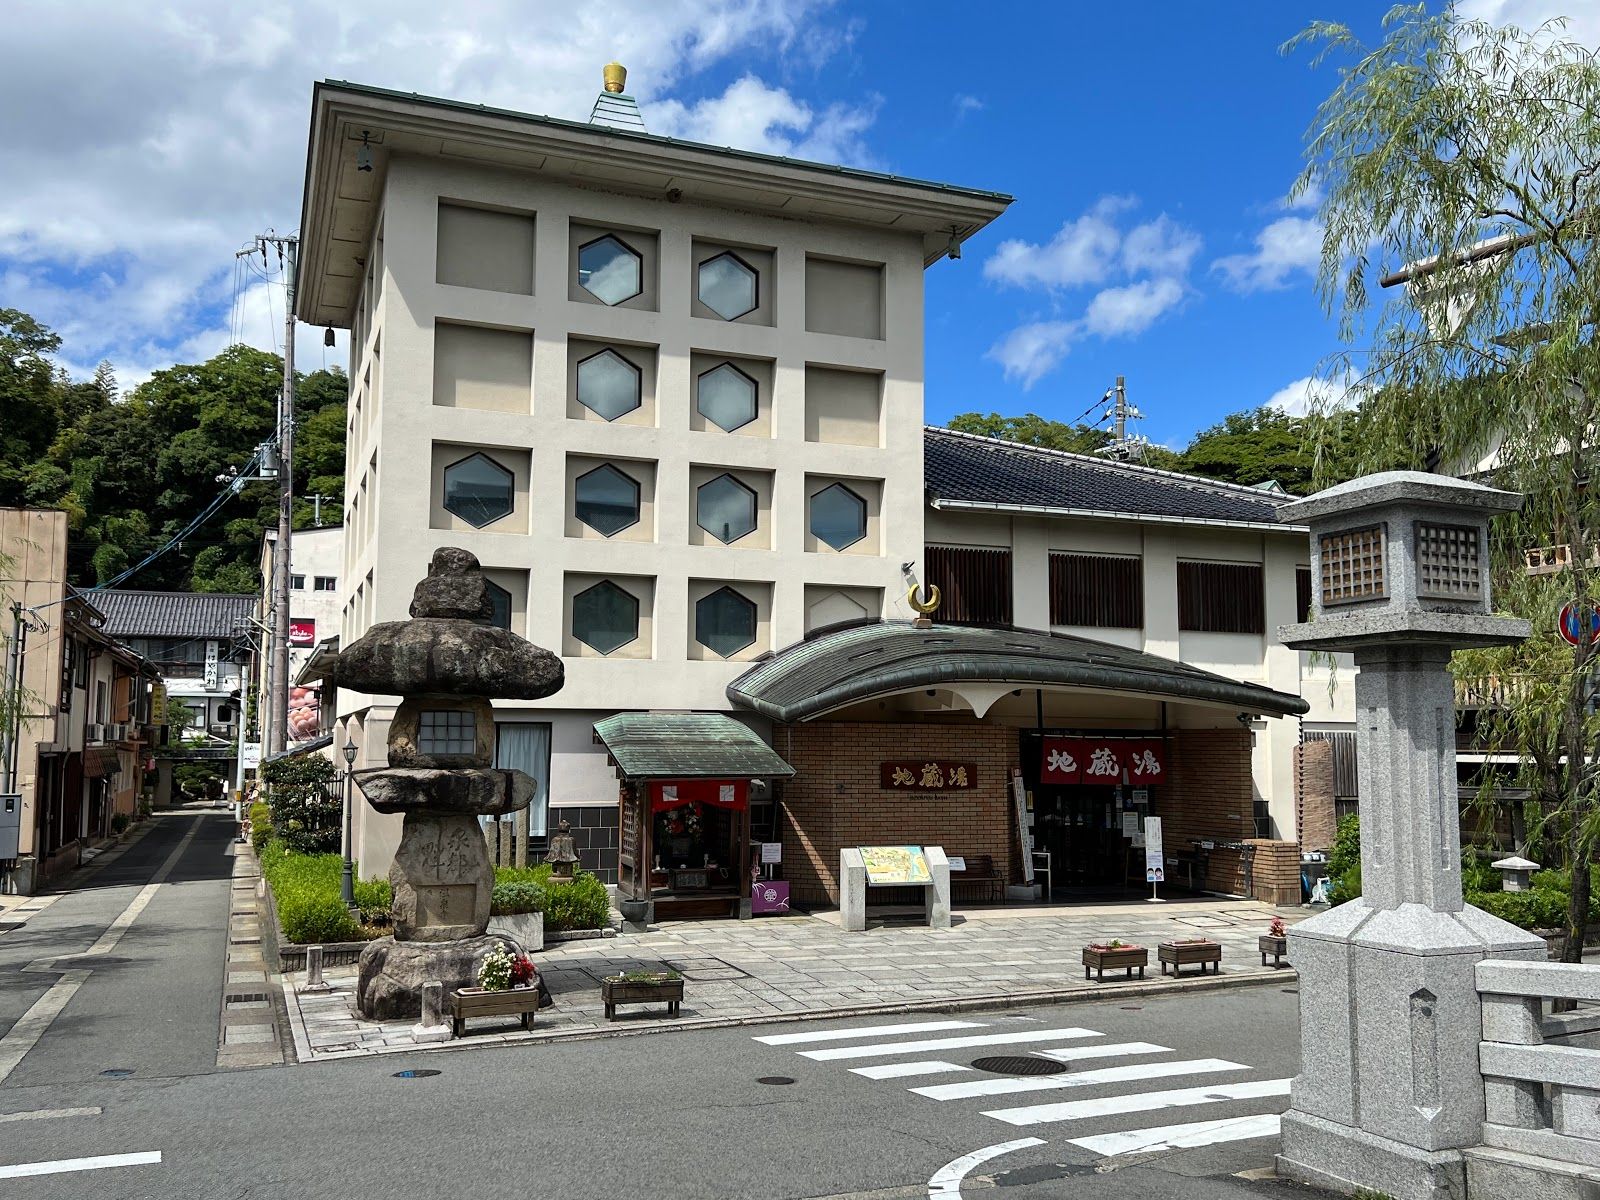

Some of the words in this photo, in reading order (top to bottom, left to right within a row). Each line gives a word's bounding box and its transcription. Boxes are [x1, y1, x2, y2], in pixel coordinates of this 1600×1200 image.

[206, 655, 216, 685] はやかわ
[1047, 748, 1161, 777] 地蔵湯
